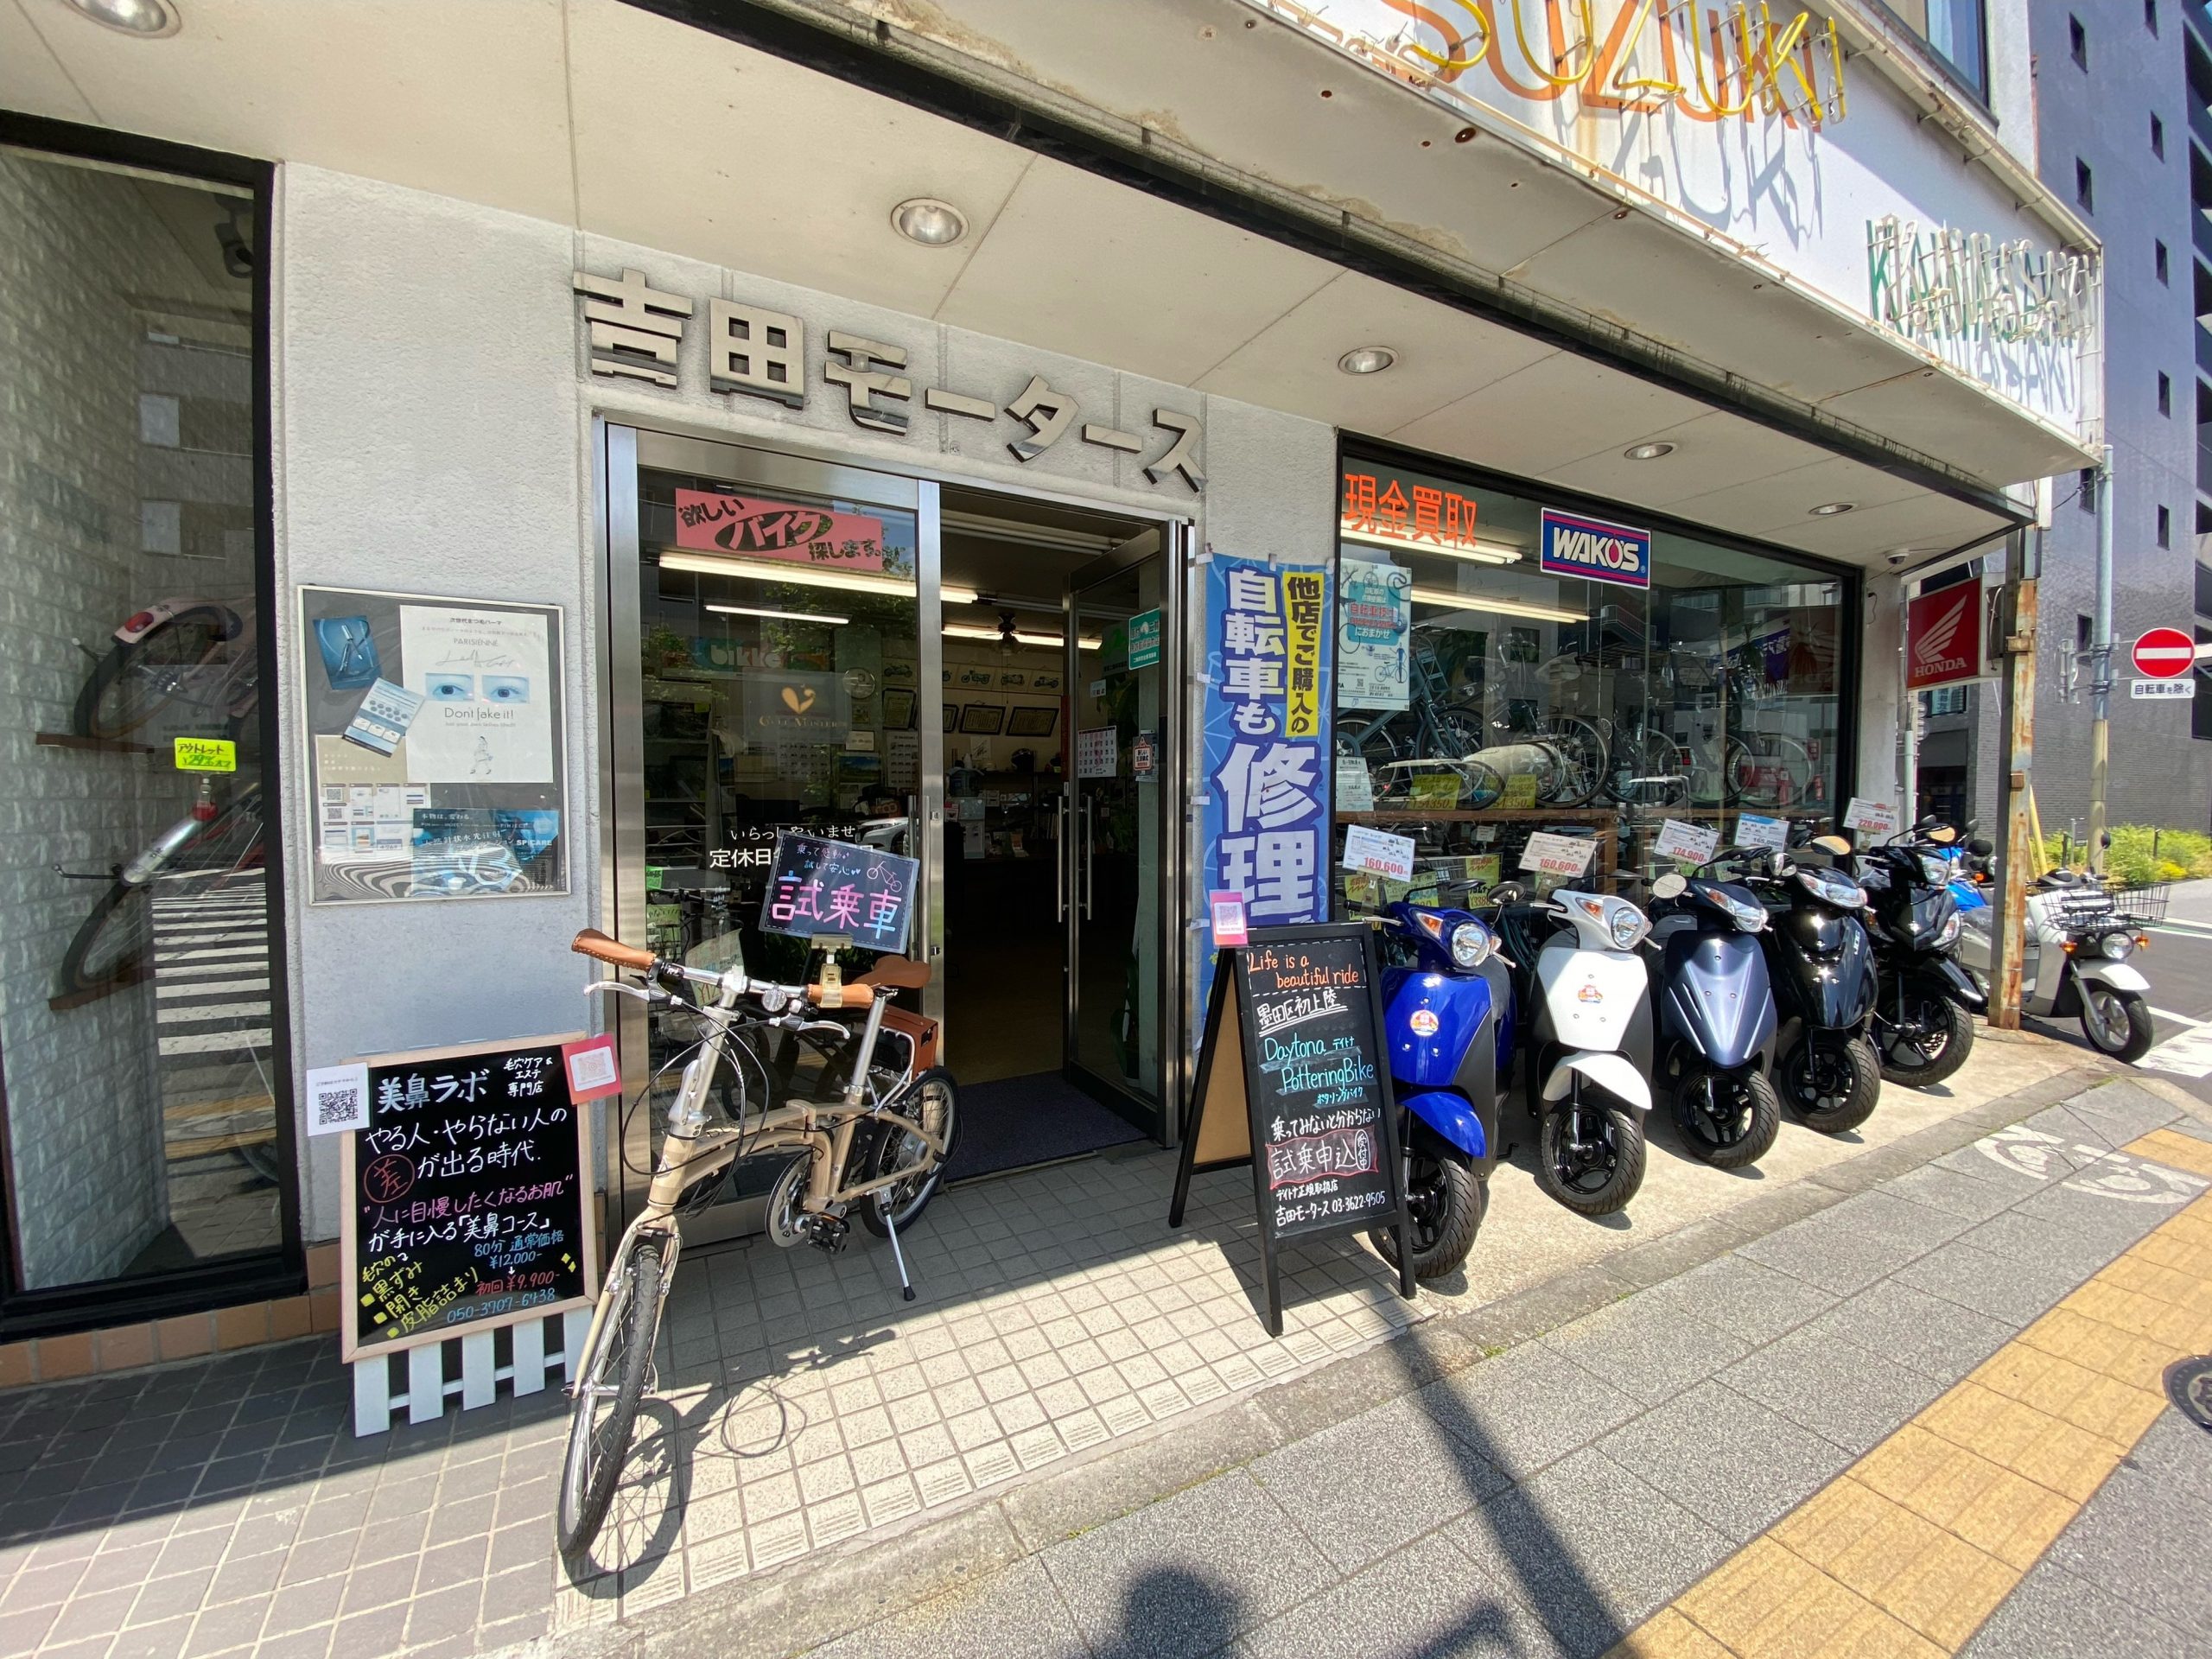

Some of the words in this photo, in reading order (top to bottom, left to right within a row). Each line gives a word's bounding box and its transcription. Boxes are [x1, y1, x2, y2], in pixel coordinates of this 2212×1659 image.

[1382, 0, 1846, 133] SUZUKI
[574, 268, 1208, 493] 吉田モータース
[677, 499, 745, 528] 欲しい
[728, 511, 821, 550] バイク
[1343, 474, 1477, 550] 現金買取
[1287, 576, 1321, 735] 他店でご購入の
[1915, 658, 1967, 677] HONDA
[772, 870, 902, 939] 試乗車
[1249, 950, 1279, 972] Life
[1285, 954, 1295, 969] is
[1300, 955, 1309, 968] a
[1275, 966, 1330, 988] beautiful
[1333, 963, 1359, 985] ride
[1256, 988, 1341, 1027] 墨田区初上陸
[1264, 1033, 1326, 1066] Daytona
[377, 1068, 490, 1114] 美鼻ラボ
[507, 1080, 544, 1097] 専門店
[515, 1069, 541, 1079] エステ
[1271, 1108, 1381, 1142] 乗ってみないと分からない
[1270, 1137, 1357, 1180] 試乗申込
[1275, 1200, 1331, 1227] 吉田モータース
[474, 1239, 506, 1257] 80分
[510, 1229, 564, 1253] 通常価格
[361, 1255, 396, 1283] 毛穴の
[372, 1261, 423, 1302] 黒ずみ
[385, 1285, 423, 1319] 開き
[400, 1266, 479, 1333] 皮脂詰まり
[475, 1280, 504, 1295] 初回
[446, 1287, 556, 1324] 050-3707-6438
